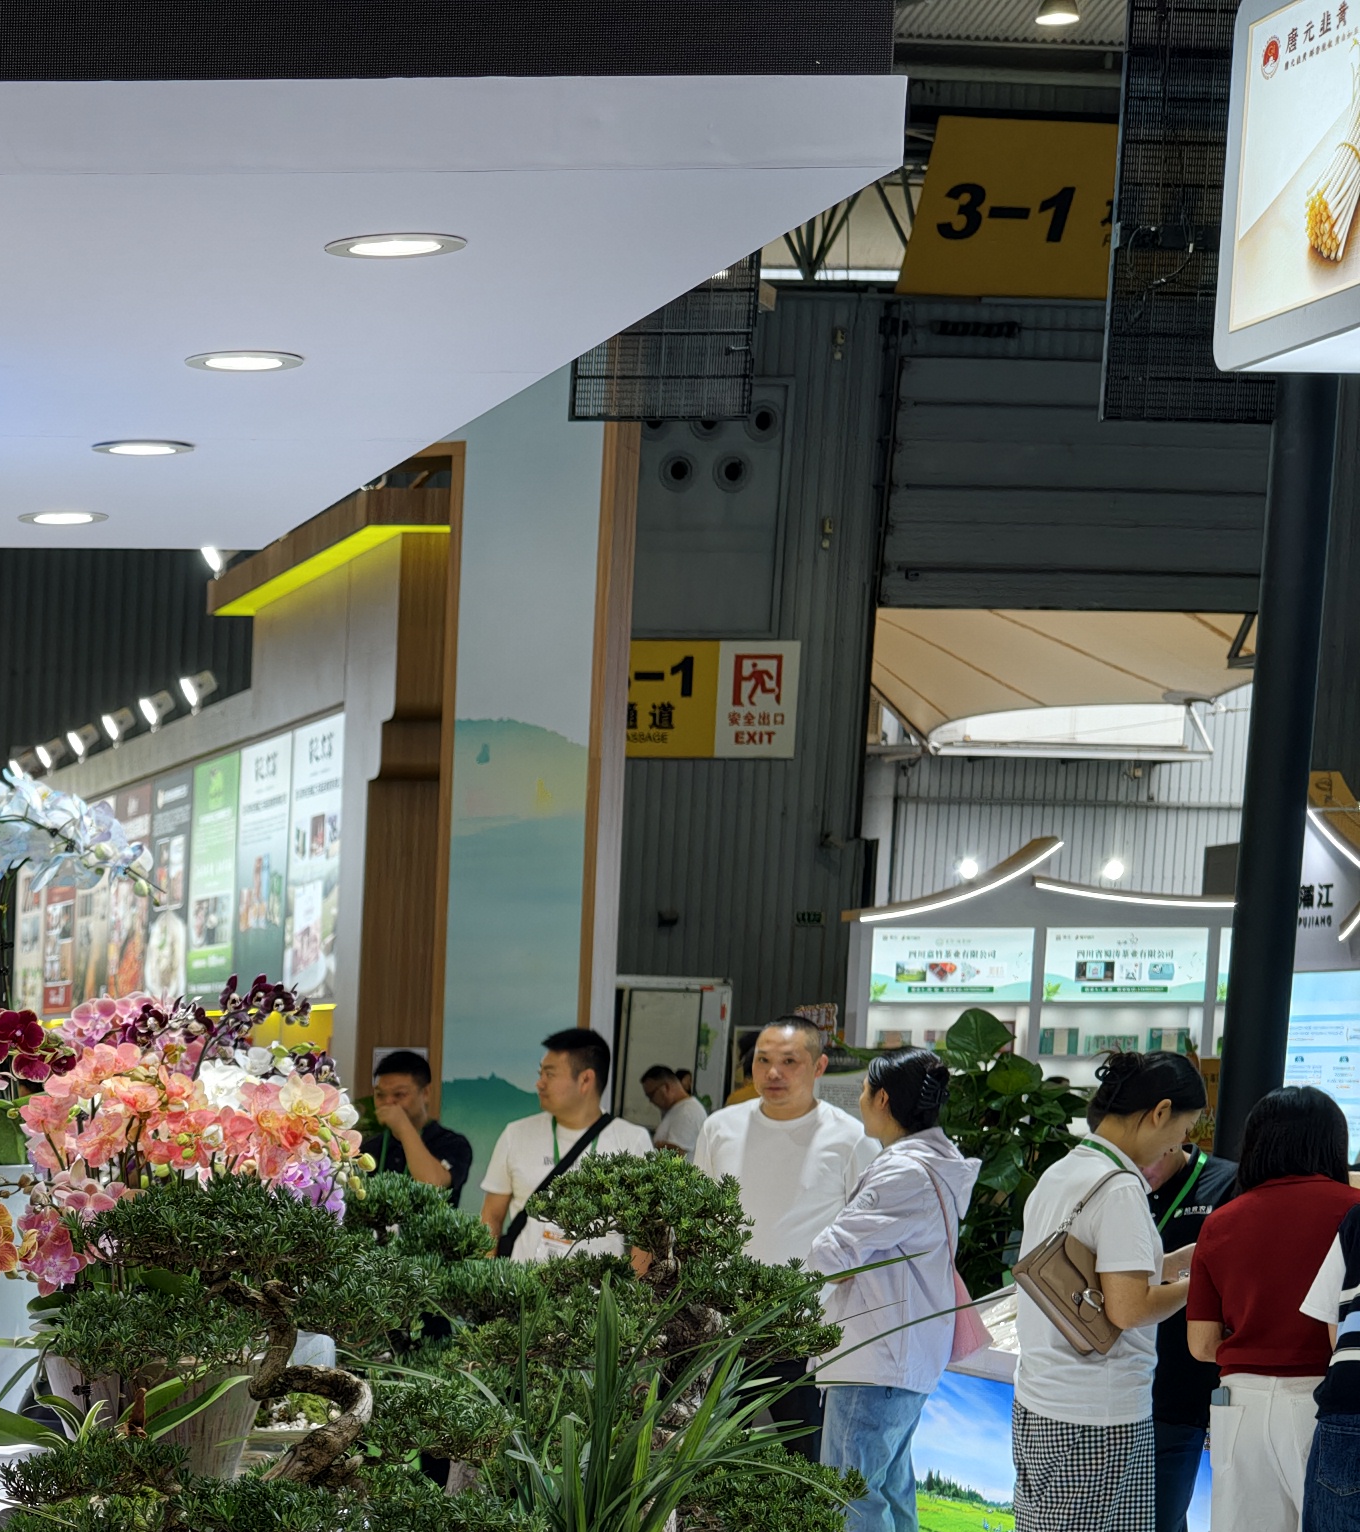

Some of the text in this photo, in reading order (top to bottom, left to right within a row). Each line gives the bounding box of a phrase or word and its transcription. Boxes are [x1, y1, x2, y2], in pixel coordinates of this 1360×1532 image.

[936, 183, 1076, 243] 3-1
[628, 655, 694, 698] -1
[728, 711, 785, 727] 安全出口
[734, 730, 776, 746] EXIT
